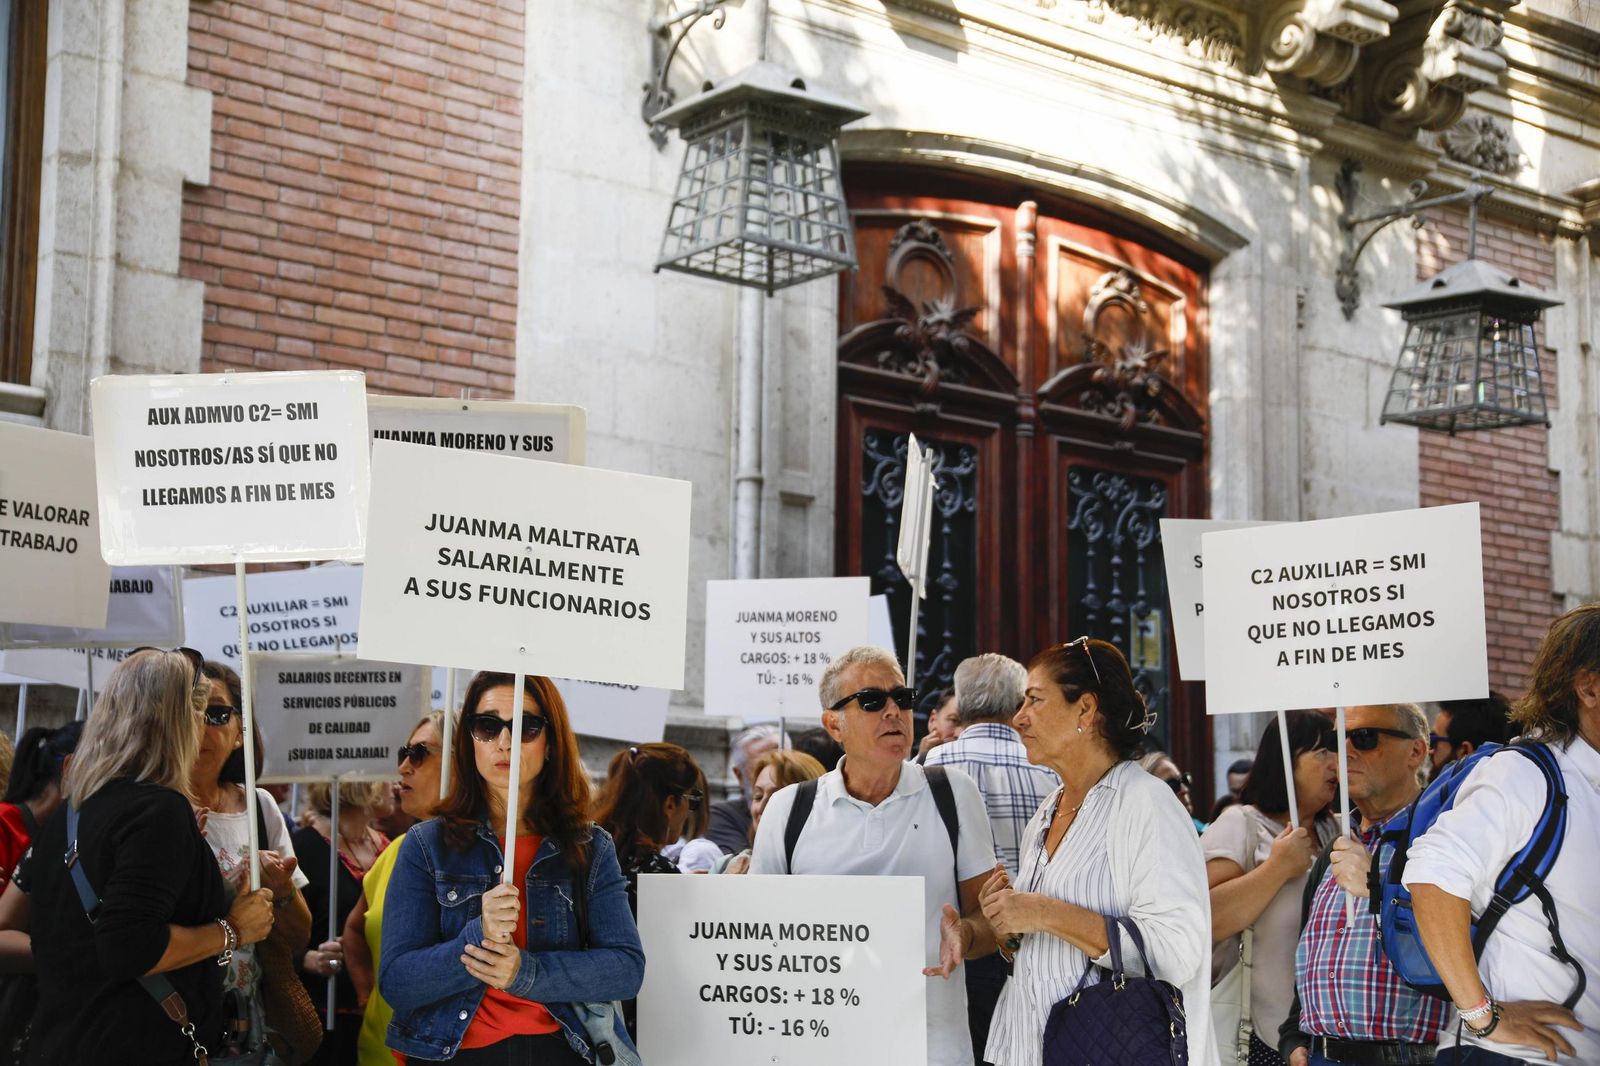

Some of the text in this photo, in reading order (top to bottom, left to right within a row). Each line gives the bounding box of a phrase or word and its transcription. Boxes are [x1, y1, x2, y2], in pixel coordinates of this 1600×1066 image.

[148, 402, 318, 425] AUX ADMVO C2= SMI
[440, 432, 506, 450] MORENO
[510, 435, 519, 450] Y
[522, 435, 553, 452] SUS
[135, 442, 337, 467] NOSOTROS/AS SÍ QUE NO
[143, 482, 335, 506] LLEGAMOS A FIN DE MES
[12, 500, 90, 527] VALORAR
[0, 529, 77, 554] TRABAJO
[424, 513, 640, 556] JUANMA MALTRATA
[437, 547, 624, 586] SALARIALMENTE
[1251, 552, 1426, 585] C2 AUXILIAR = SMI
[220, 606, 238, 617] C2
[323, 596, 348, 608] SMI
[403, 577, 651, 621] A SUS FUNCIONARIOS
[1272, 584, 1405, 611] NOSOTROS SI
[248, 616, 337, 634] OSOTROS SI
[736, 611, 837, 623] JUANMA MORENO
[1248, 610, 1435, 644] QUE NO LLEGAMOS
[258, 640, 279, 651] NO
[750, 632, 821, 643] Y SUS ALTOS
[740, 652, 790, 664] CARGOS:
[1277, 642, 1405, 666] A FIN DE MES
[278, 671, 401, 684] SALARIOS DECENTES EN
[757, 669, 775, 685] TÚ:
[283, 694, 396, 709] SERVICIOS PÚBLICOS
[309, 722, 370, 734] DE CALIDAD
[288, 747, 389, 762] ¡SUBIDA SALARIAL!
[689, 922, 870, 942] JUANMA MORENO
[716, 953, 841, 974] Y SUS ALTOS
[699, 984, 788, 1004] CARGOS:
[811, 988, 835, 1005] 18
[729, 1012, 763, 1035] TÚ:
[781, 1019, 804, 1036] 16
